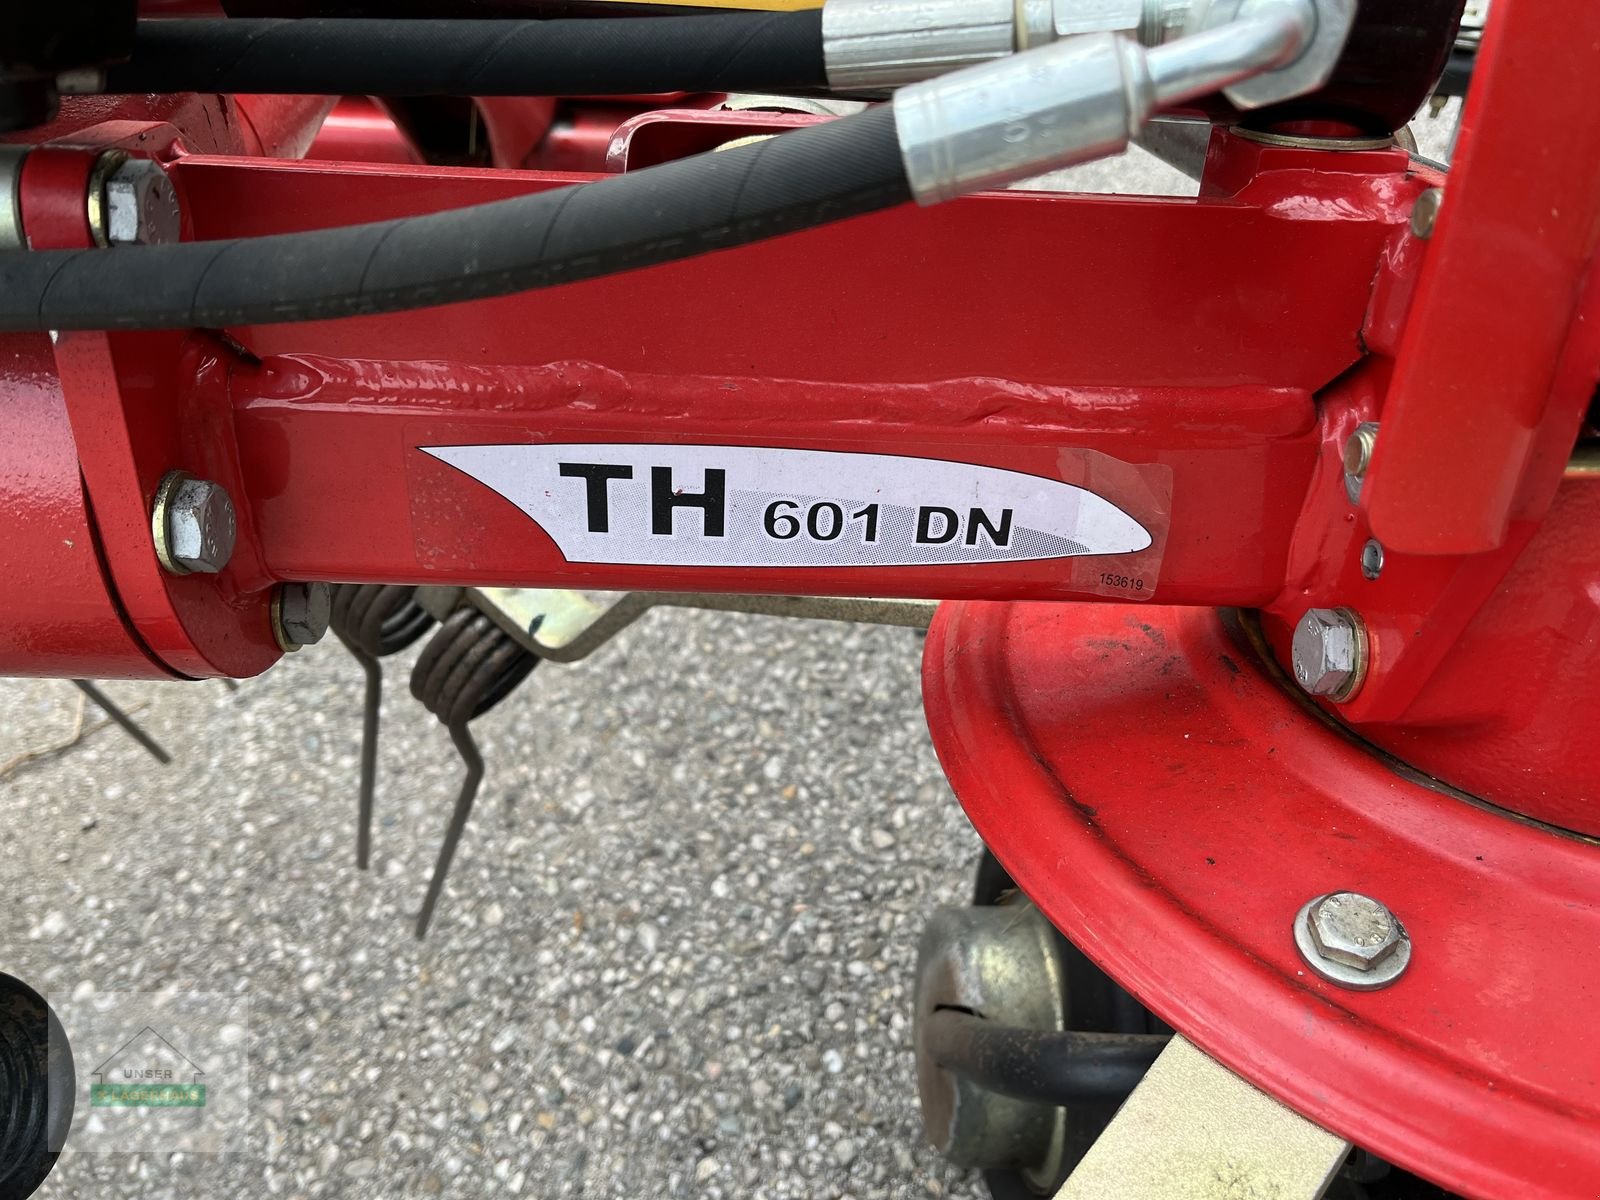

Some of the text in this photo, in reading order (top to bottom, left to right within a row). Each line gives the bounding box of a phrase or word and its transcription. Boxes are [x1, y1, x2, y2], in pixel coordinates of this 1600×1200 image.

[559, 462, 1014, 548] TH 601 DN
[1099, 573, 1144, 590] 153619
